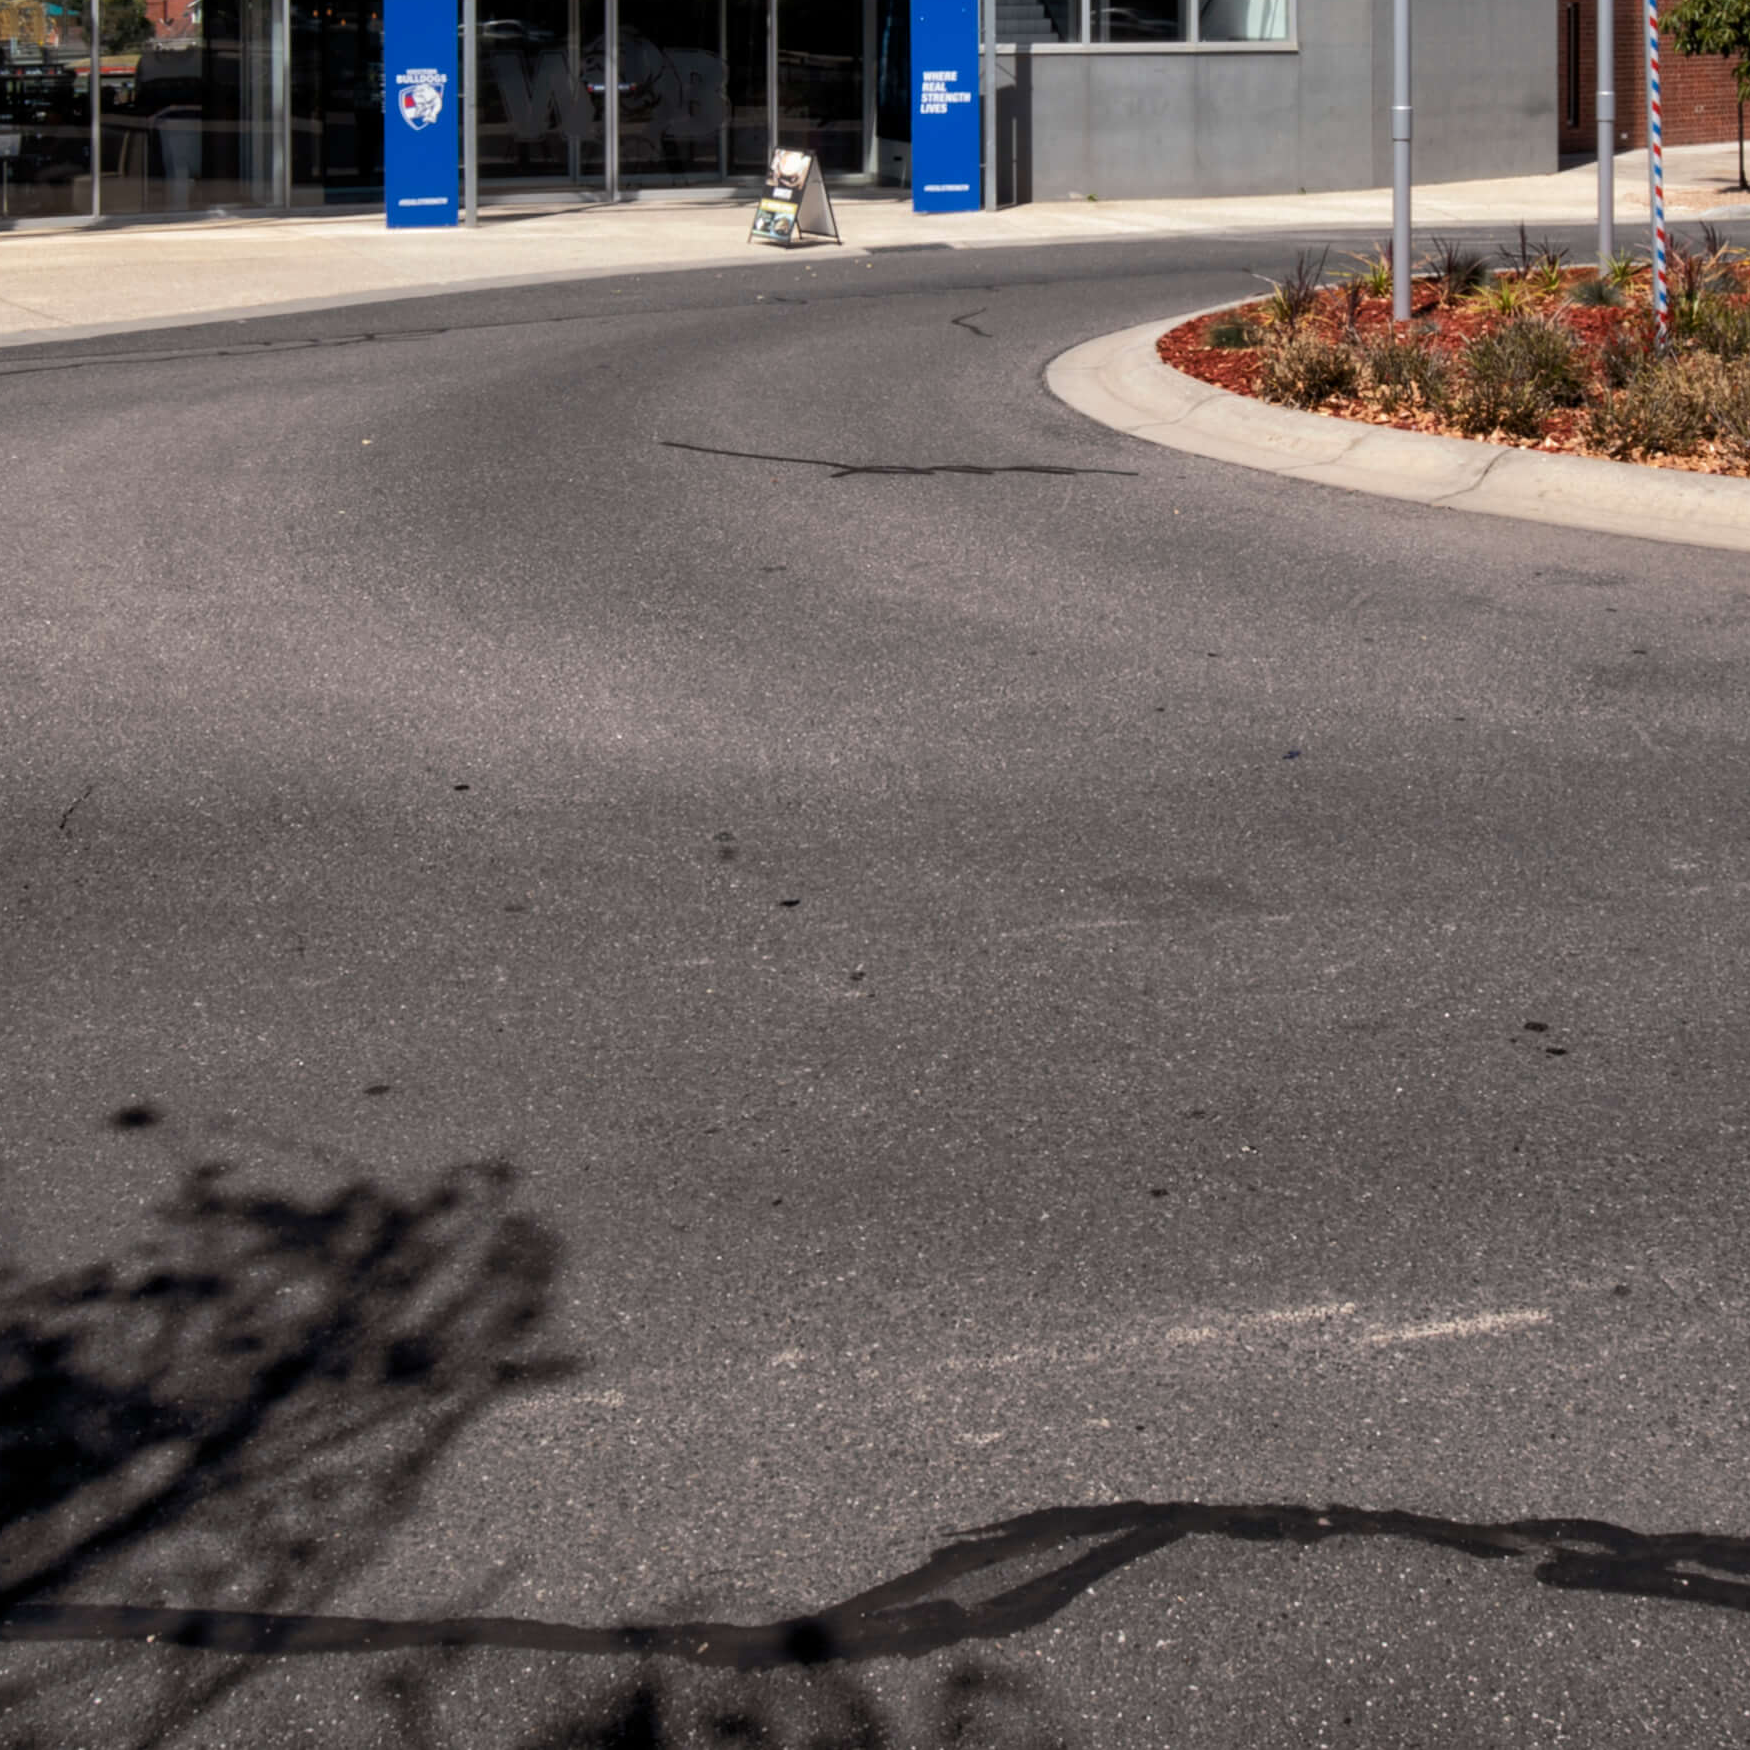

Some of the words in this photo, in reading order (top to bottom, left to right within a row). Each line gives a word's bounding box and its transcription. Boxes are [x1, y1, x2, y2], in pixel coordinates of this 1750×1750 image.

[923, 70, 957, 82] WHERE
[922, 82, 946, 92] REAL
[921, 92, 971, 103] STRENGTH
[920, 103, 948, 114] LIVES
